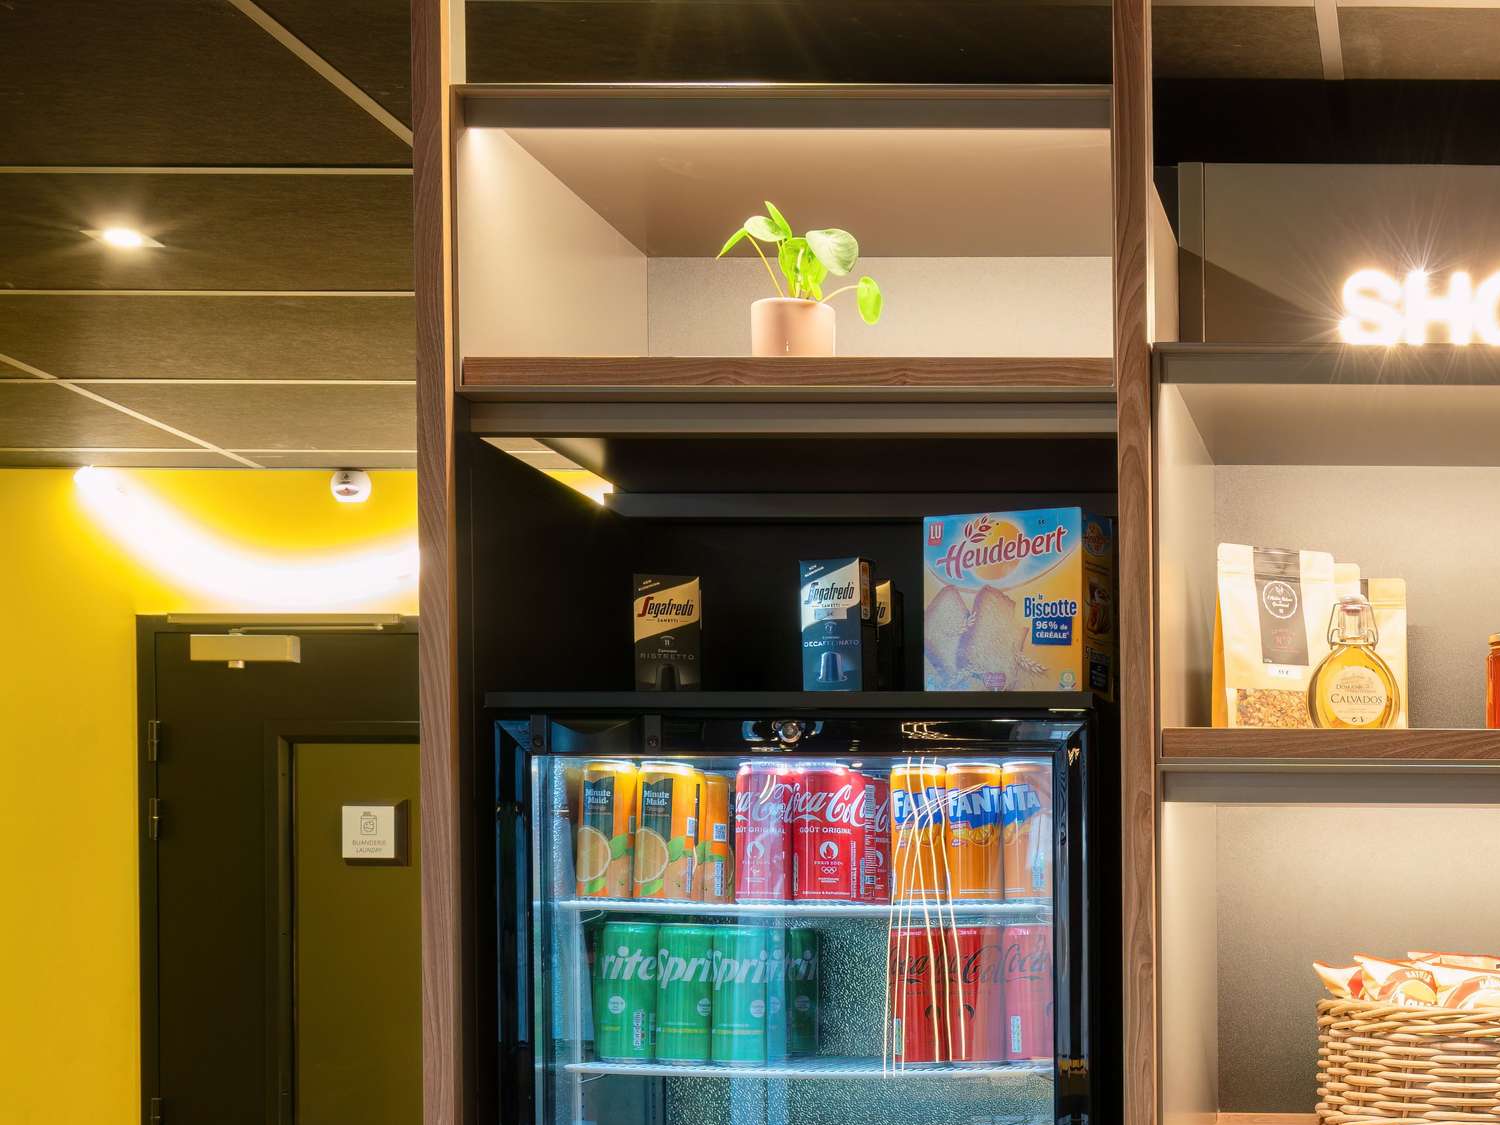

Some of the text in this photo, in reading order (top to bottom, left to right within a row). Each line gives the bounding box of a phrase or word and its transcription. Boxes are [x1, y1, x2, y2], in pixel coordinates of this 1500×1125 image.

[930, 525, 941, 539] LU
[936, 527, 1067, 579] Heudebert
[804, 582, 855, 604] Segafredo
[638, 596, 694, 618] Segafredo
[1024, 597, 1077, 617] Biscotte
[1331, 694, 1383, 704] CALVADOS
[585, 788, 611, 797] Minute
[587, 796, 607, 804] Maid
[643, 790, 670, 798] Minute
[646, 797, 666, 805] Maid
[893, 788, 946, 817] FANT
[948, 786, 1000, 817] FANT
[1001, 784, 1041, 814] NTA
[602, 946, 657, 980] rite
[657, 949, 714, 989] Spri
